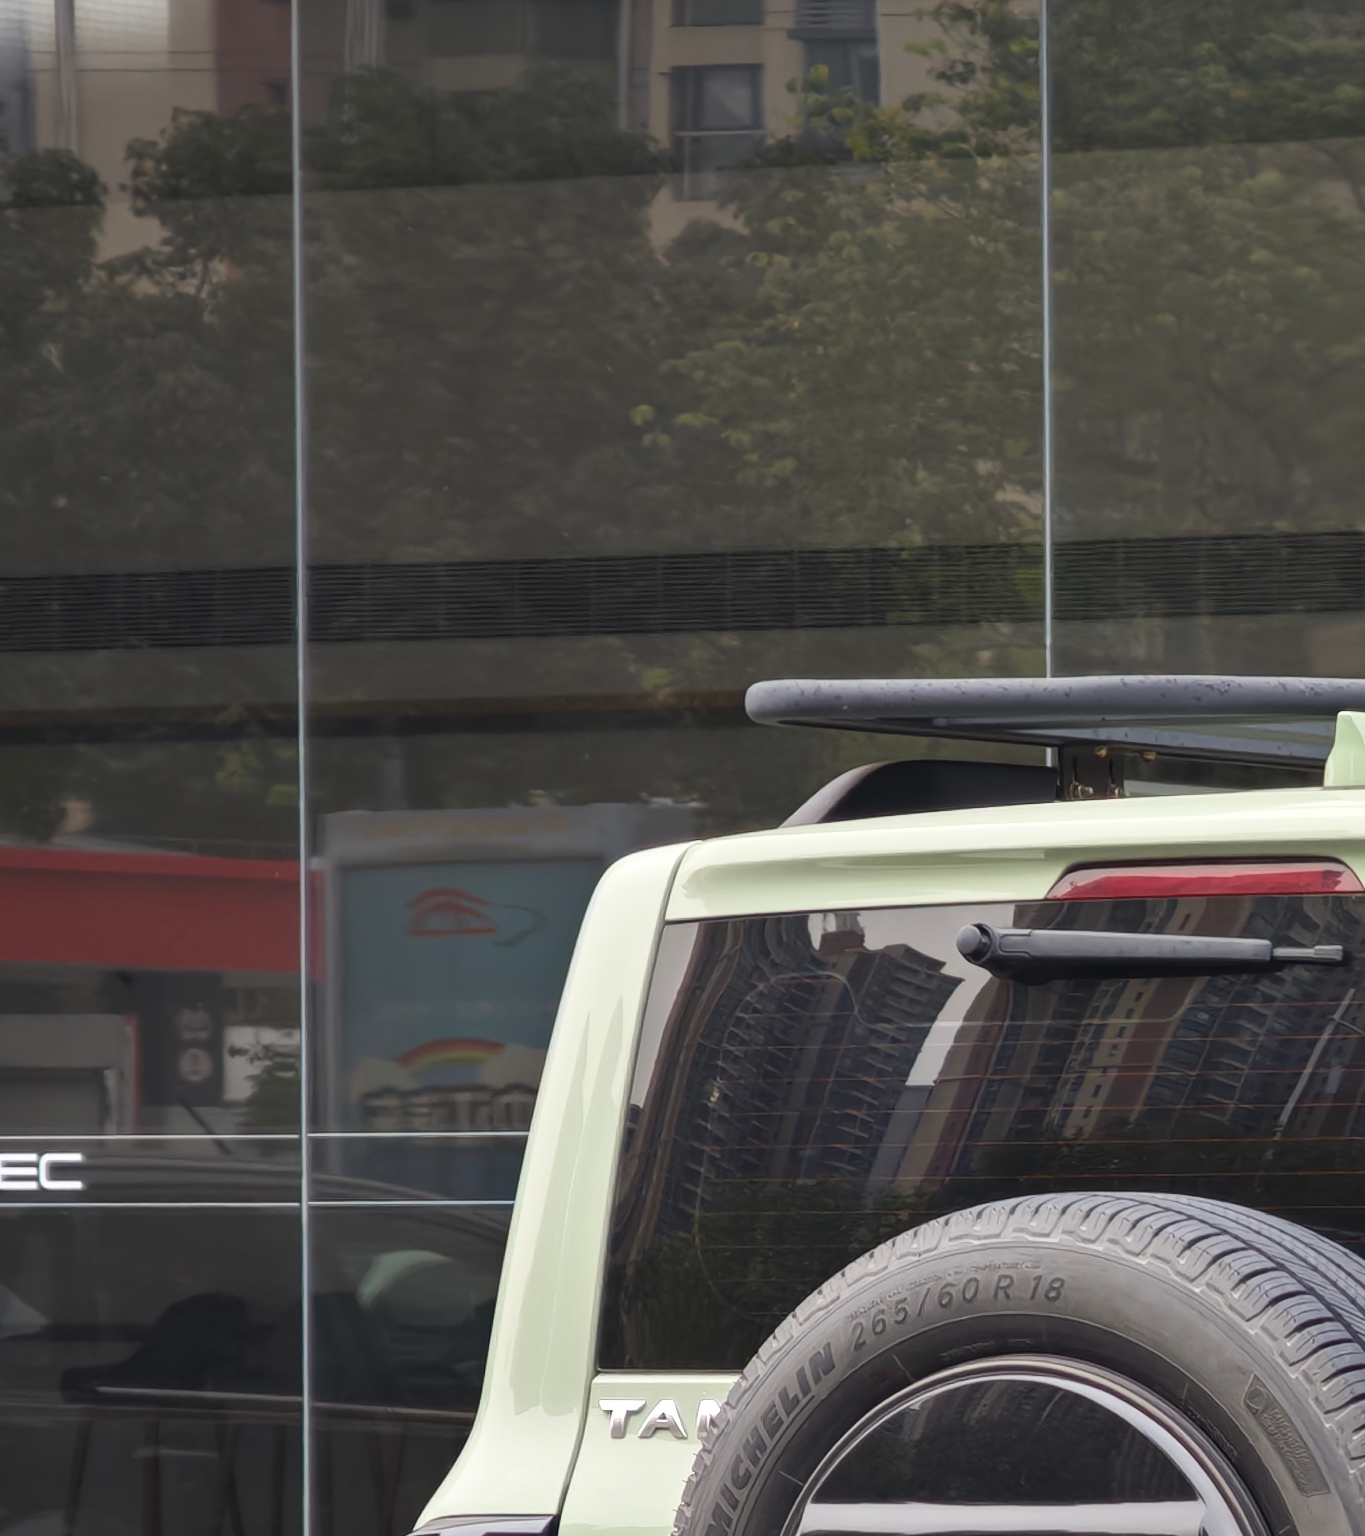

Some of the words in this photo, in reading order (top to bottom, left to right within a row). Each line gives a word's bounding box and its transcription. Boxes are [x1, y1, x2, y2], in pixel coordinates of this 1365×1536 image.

[850, 1276, 981, 1352] 265/60
[992, 1274, 1014, 1301] R
[1029, 1274, 1067, 1302] 18
